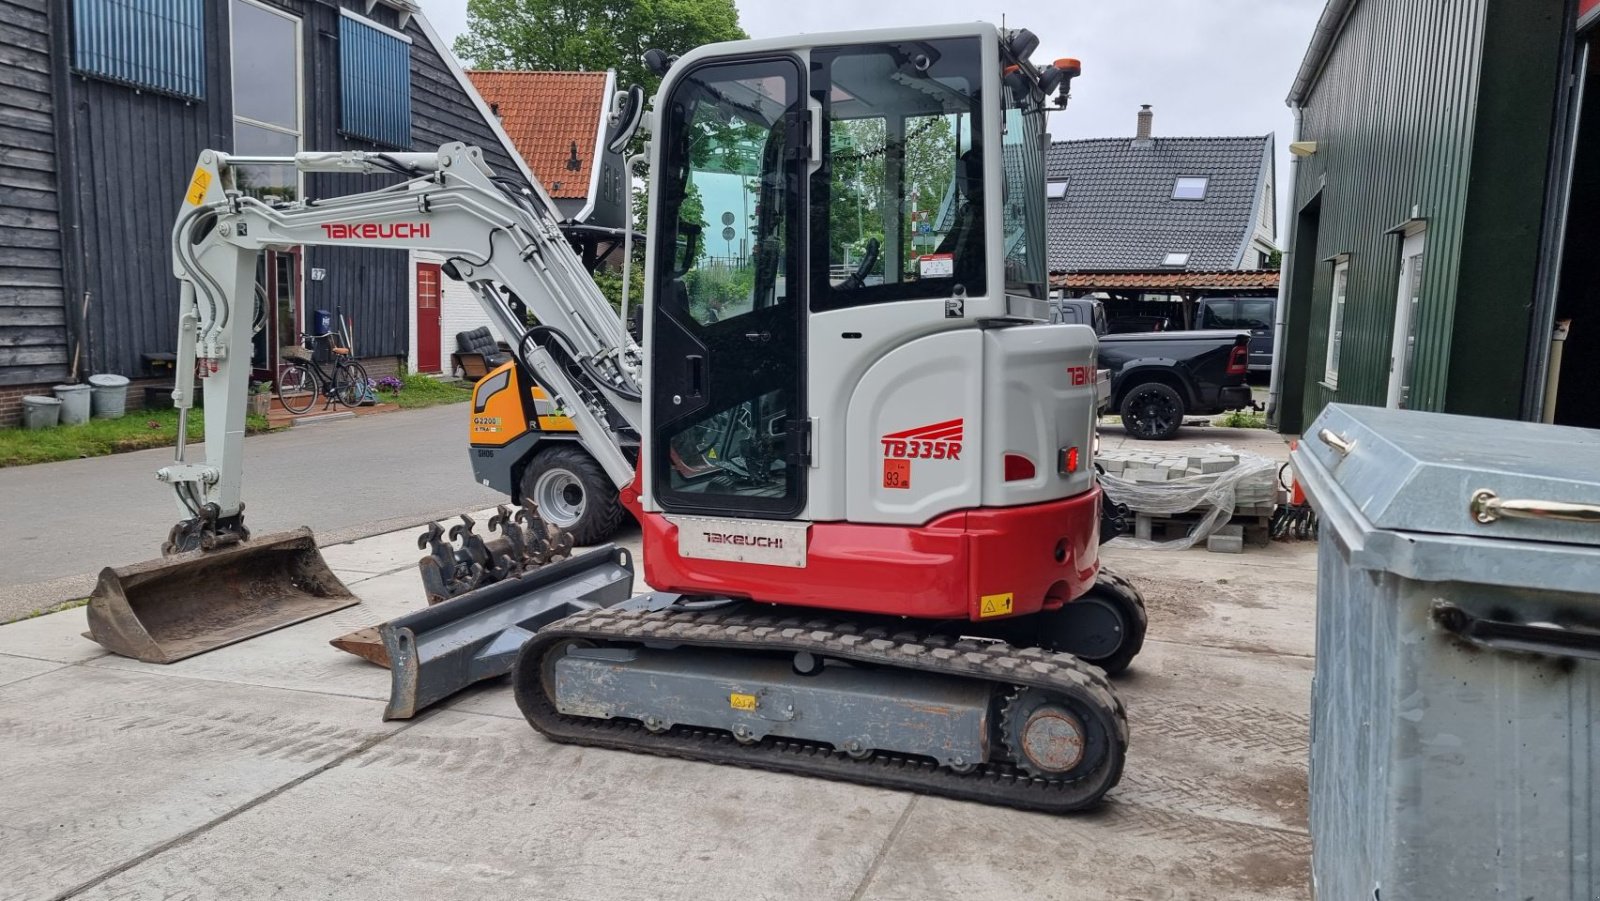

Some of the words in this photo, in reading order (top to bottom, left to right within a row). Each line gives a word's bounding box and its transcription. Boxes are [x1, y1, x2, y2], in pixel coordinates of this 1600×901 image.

[321, 223, 430, 239] TAKEUCHI
[881, 440, 962, 460] TB335R
[886, 472, 899, 486] 93
[703, 532, 783, 549] TAKEUCHI
